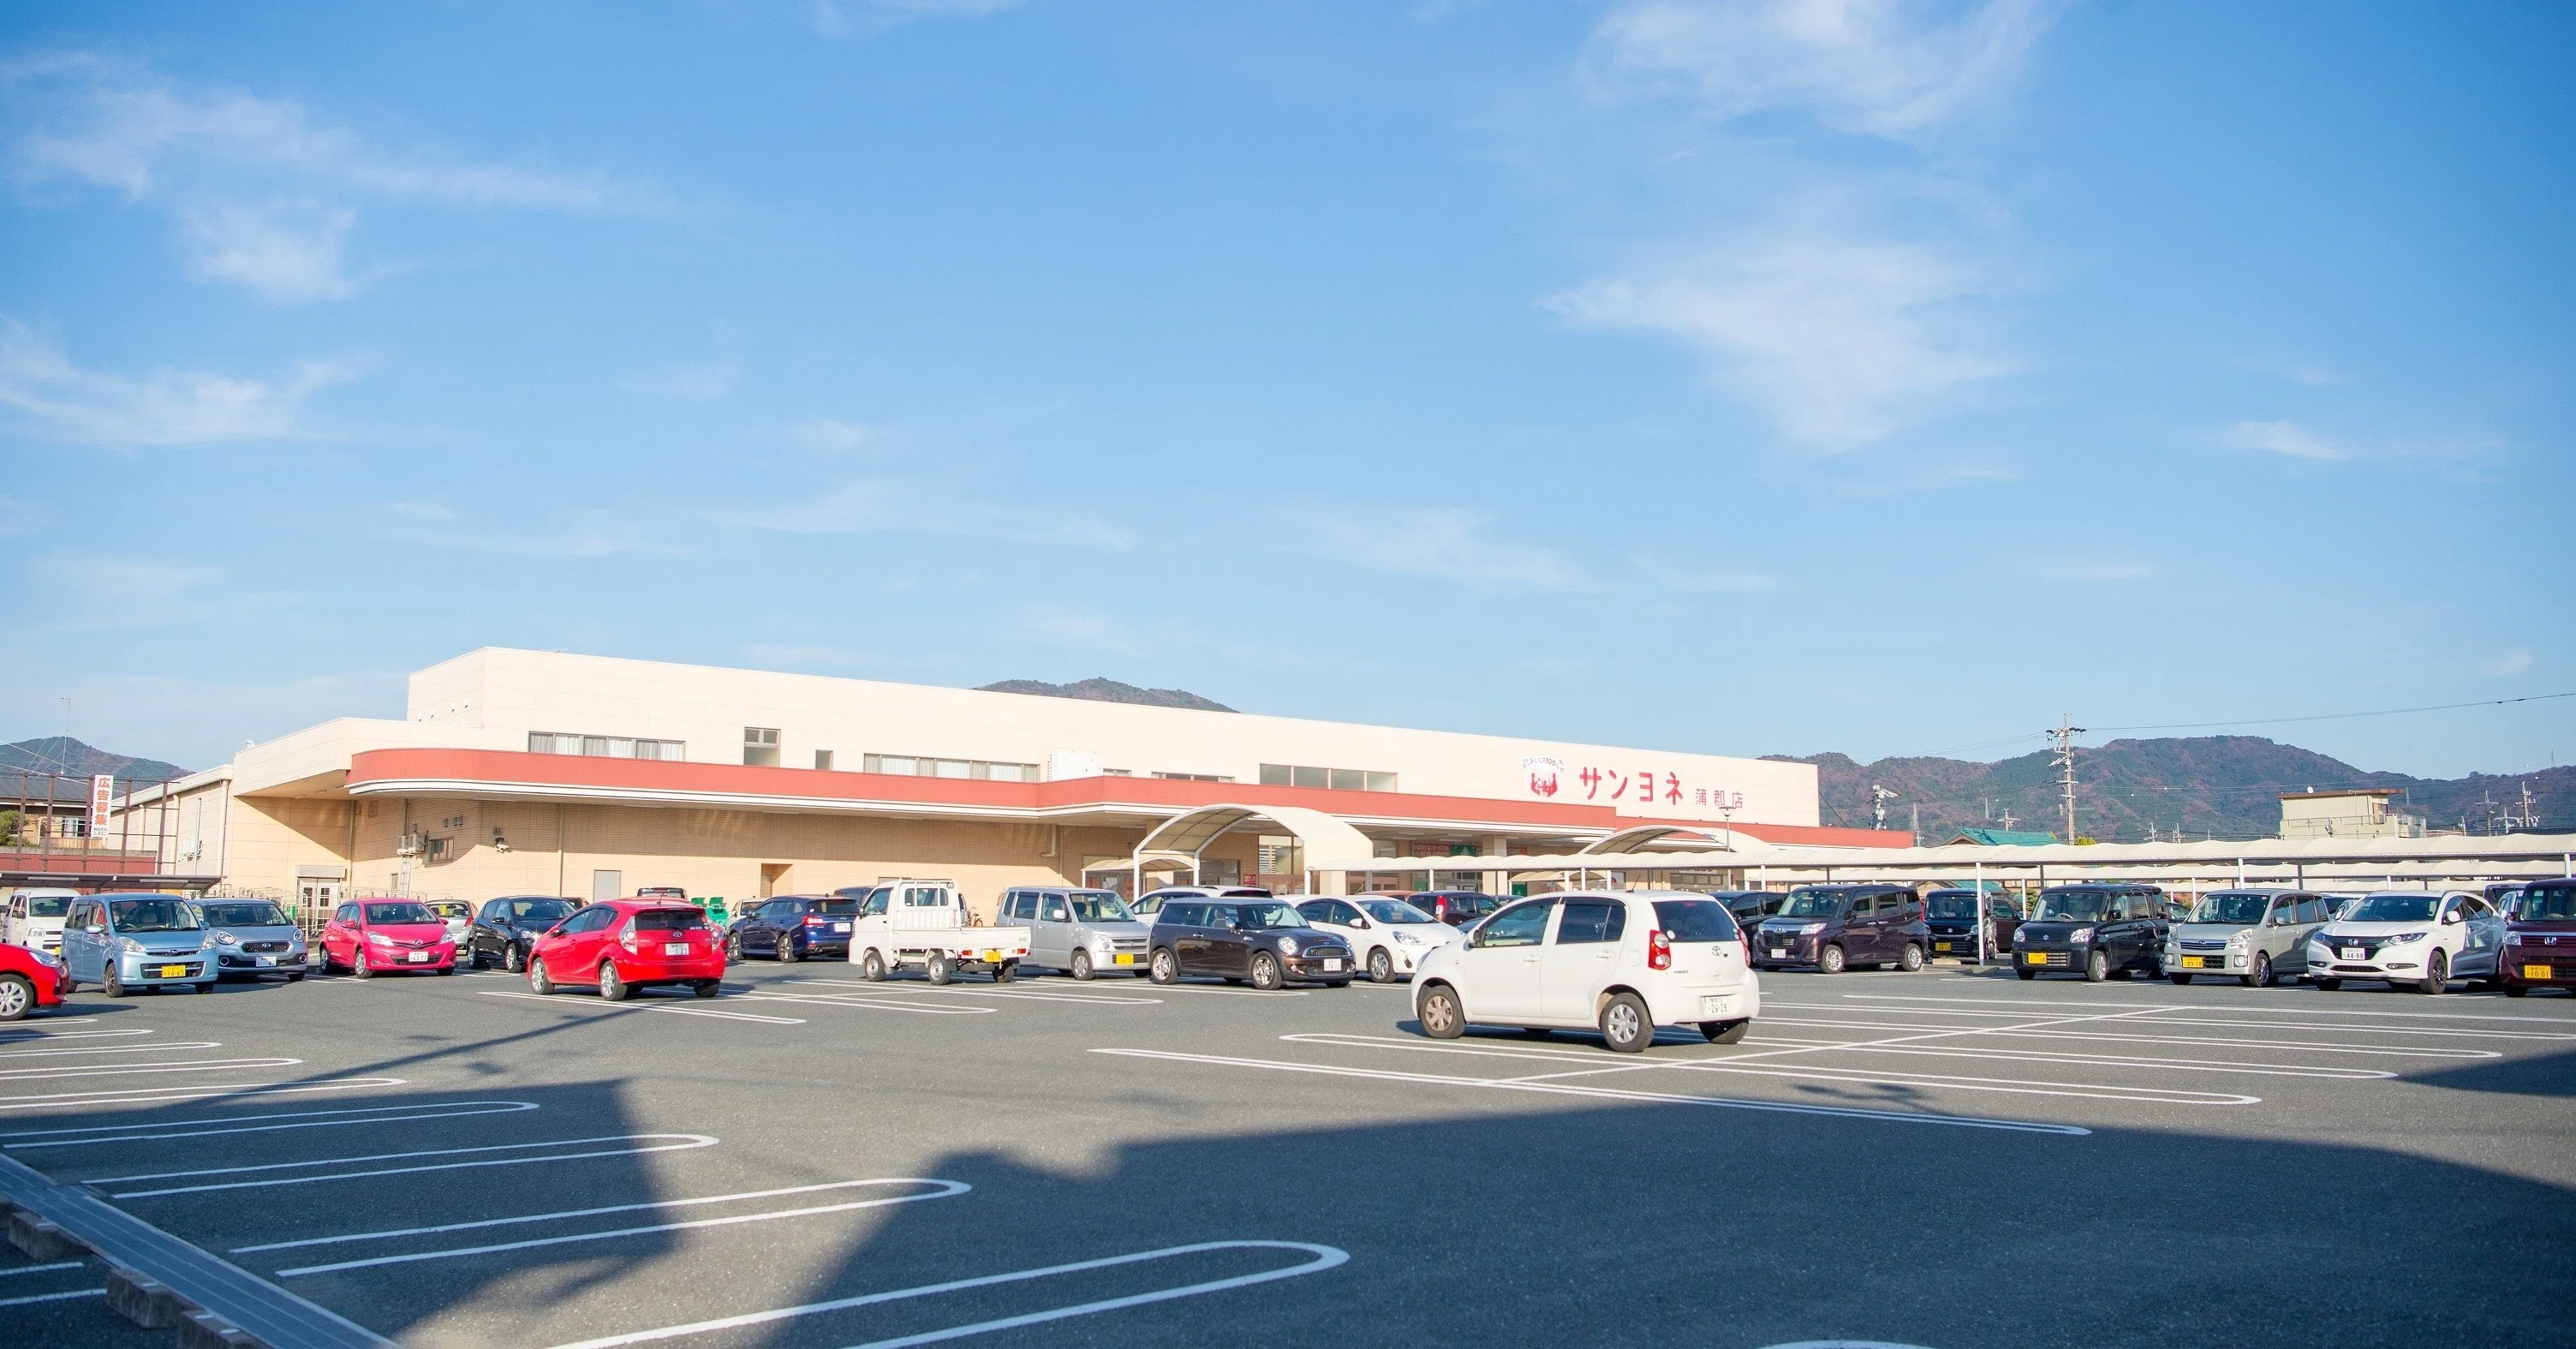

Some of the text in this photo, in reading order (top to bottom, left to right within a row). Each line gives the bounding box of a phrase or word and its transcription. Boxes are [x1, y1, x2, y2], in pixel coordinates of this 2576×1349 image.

[94, 777, 111, 826] 広告募集
[1579, 767, 1684, 806] サンヨネ
[1695, 788, 1743, 809] 蒲郡店
